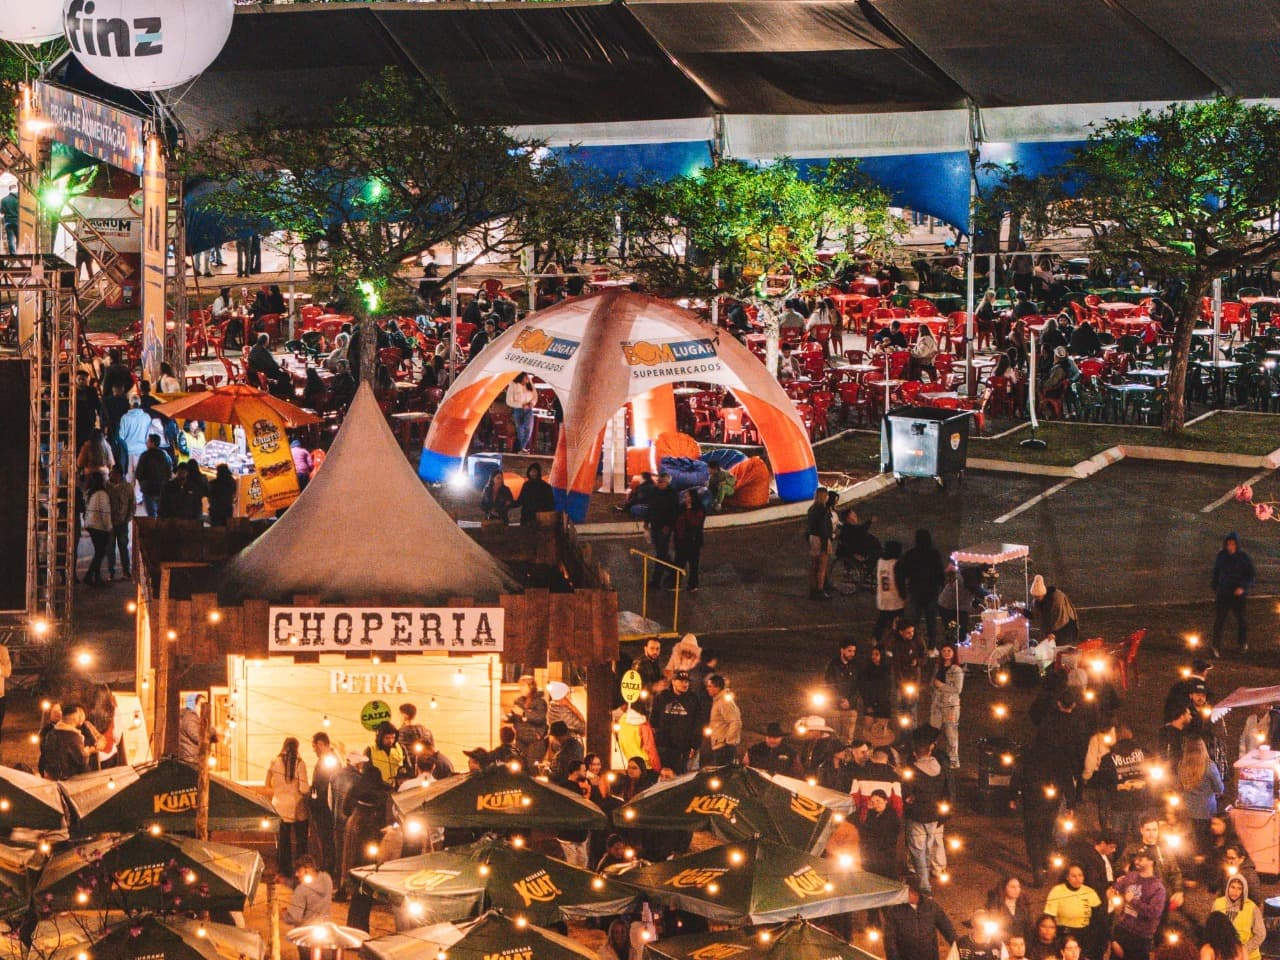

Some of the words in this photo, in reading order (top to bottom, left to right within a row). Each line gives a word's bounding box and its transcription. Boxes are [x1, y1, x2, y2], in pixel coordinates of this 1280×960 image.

[50, 104, 71, 131] PRAÇA
[72, 111, 81, 132] DE
[674, 342, 714, 357] LUGAR
[505, 352, 564, 373] SUPERMERCADOS
[633, 363, 721, 379] SUPERMERCADOS
[274, 612, 496, 646] CHOPERIA
[330, 670, 408, 693] PETRA
[622, 682, 640, 690] CAIXA
[361, 711, 391, 721] CAIXA
[154, 792, 198, 813] KUAT
[477, 793, 522, 811] KUAT
[685, 796, 737, 819] KUAT
[112, 868, 164, 890] KUAT
[513, 874, 561, 907] KUAT
